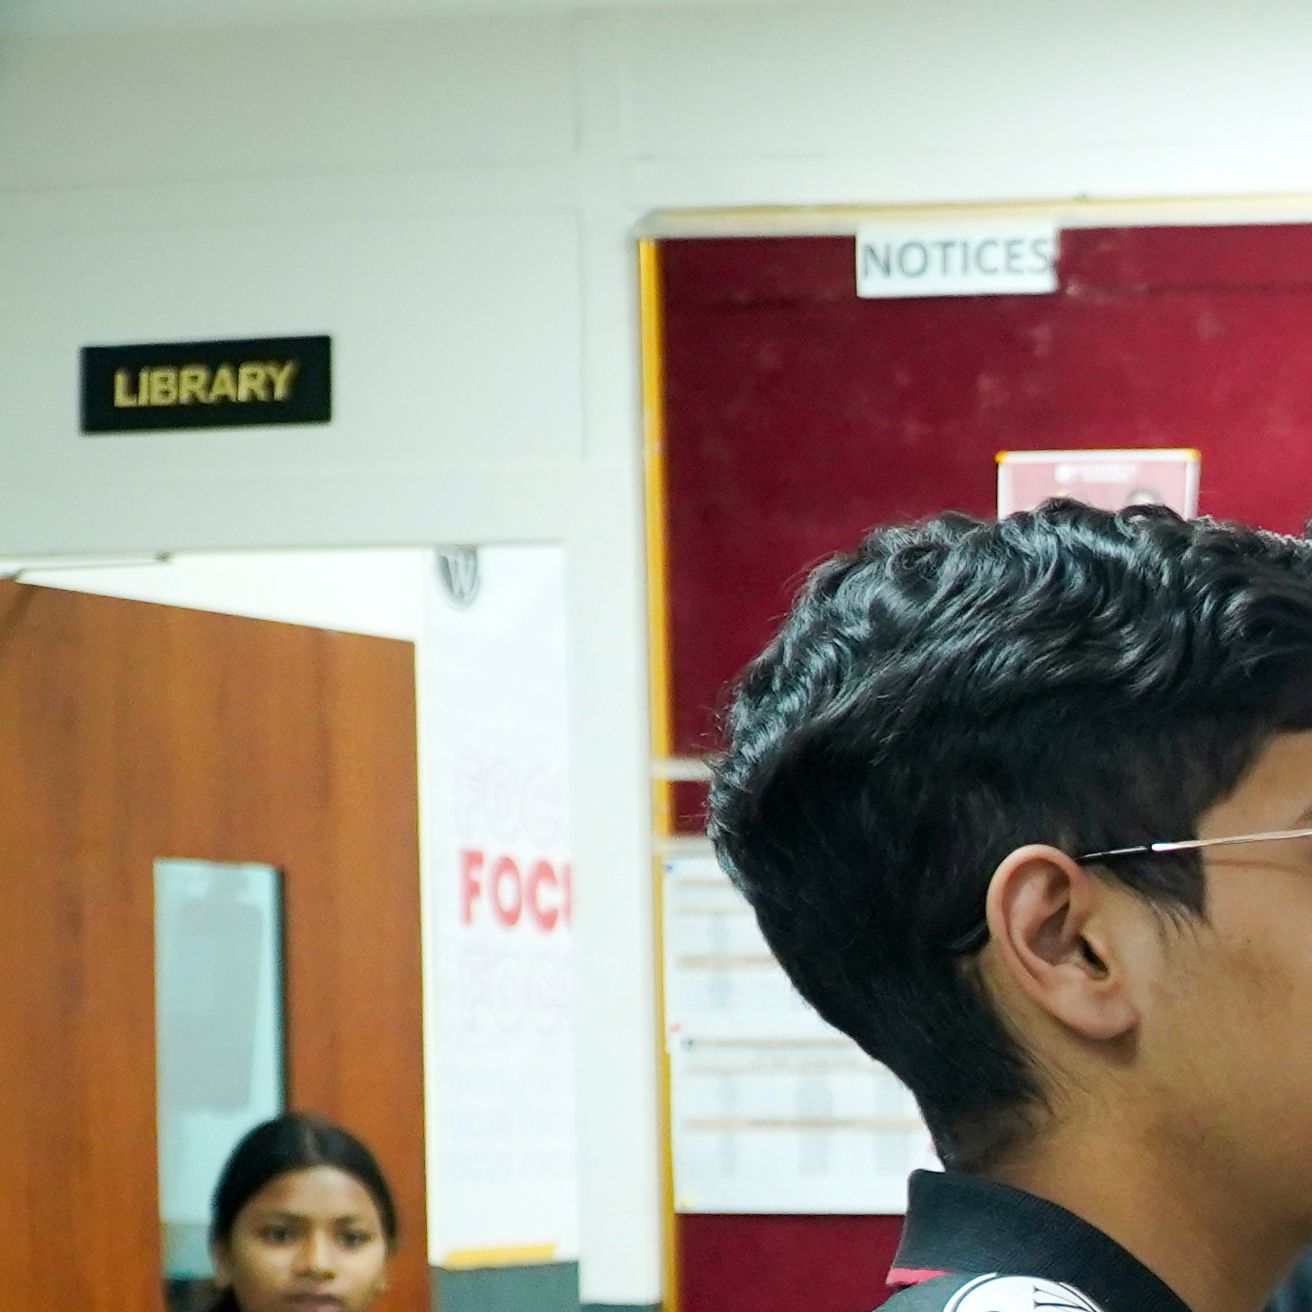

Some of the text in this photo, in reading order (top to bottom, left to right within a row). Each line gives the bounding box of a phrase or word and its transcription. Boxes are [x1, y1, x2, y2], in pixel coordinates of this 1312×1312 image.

[862, 238, 1054, 278] NOTICES
[113, 358, 299, 408] LIBRARY
[459, 848, 572, 933] FOC
